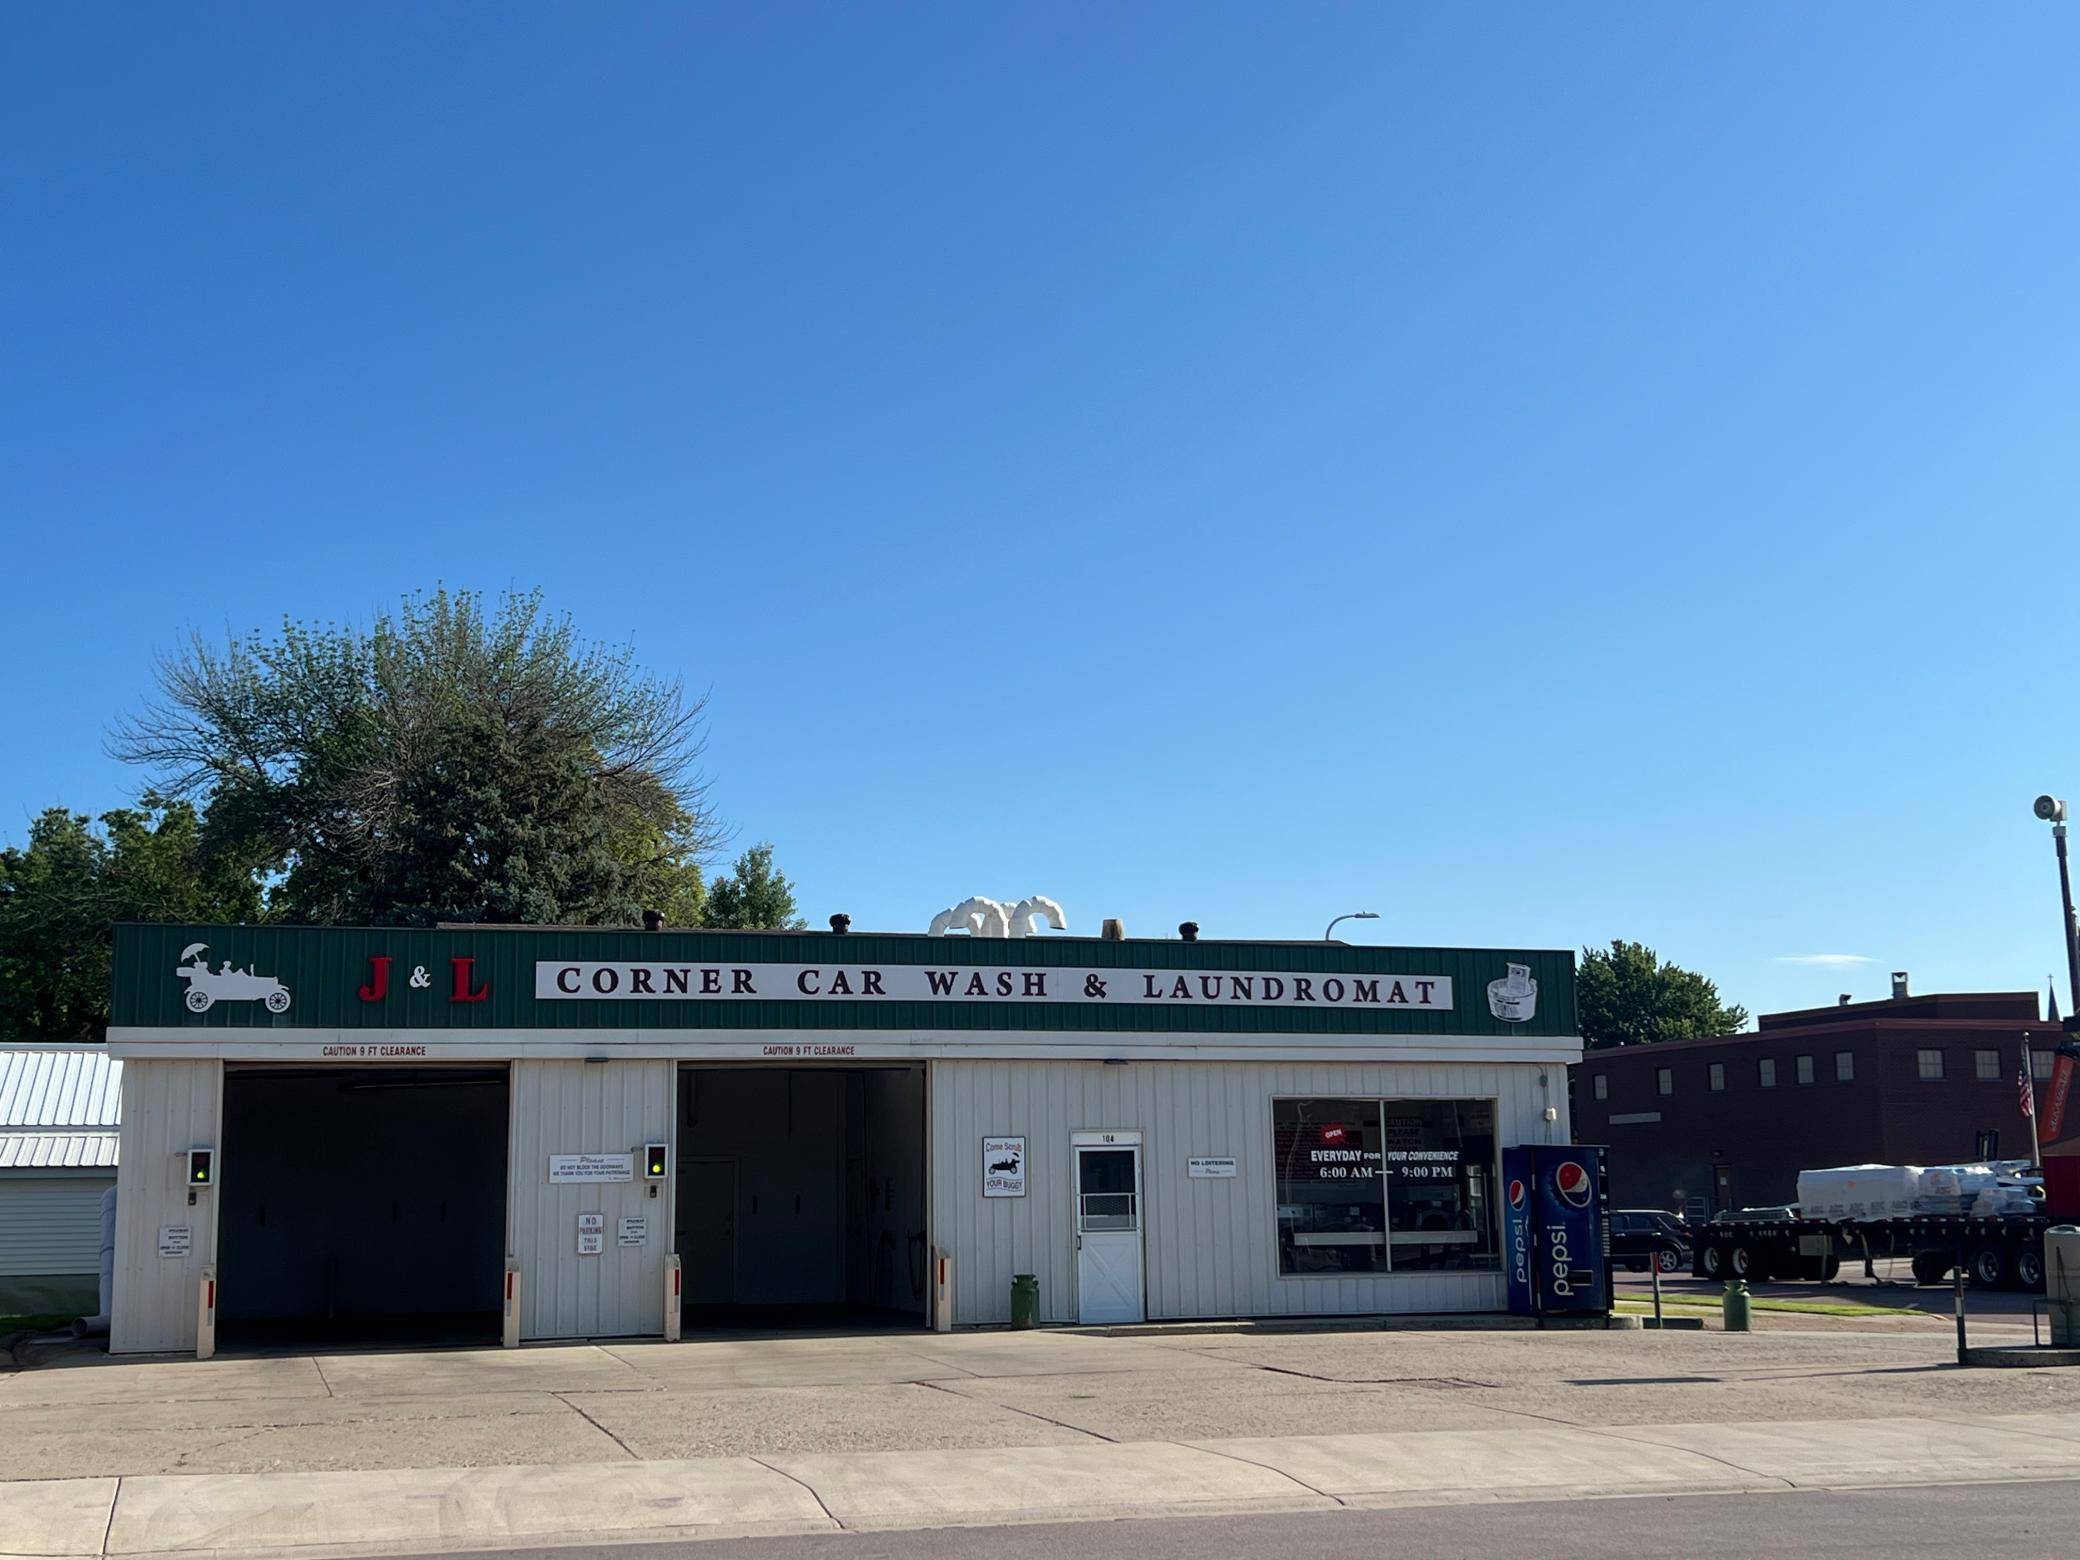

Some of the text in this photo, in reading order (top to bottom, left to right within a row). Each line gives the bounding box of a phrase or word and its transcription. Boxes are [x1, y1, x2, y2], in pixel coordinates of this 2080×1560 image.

[357, 956, 489, 1003] J & L
[557, 967, 1436, 1005] CORNER CAR WASH & LAUNDROMAT
[322, 1046, 426, 1056] CAUTION 9 FT CLEARANCE
[763, 1046, 855, 1056] CAUTION 9 FT CLEARANCE
[1324, 1128, 1343, 1139] OPEN
[1310, 1150, 1459, 1162] EVERYDAY FOR YOUR CONVENIENCE
[1319, 1166, 1454, 1178] 6:00 AM 9:00 PM
[986, 1179, 1003, 1188] YOUR
[585, 1217, 597, 1225] NO
[1512, 1218, 1527, 1284] pepsi
[1546, 1225, 1575, 1296] pepsi
